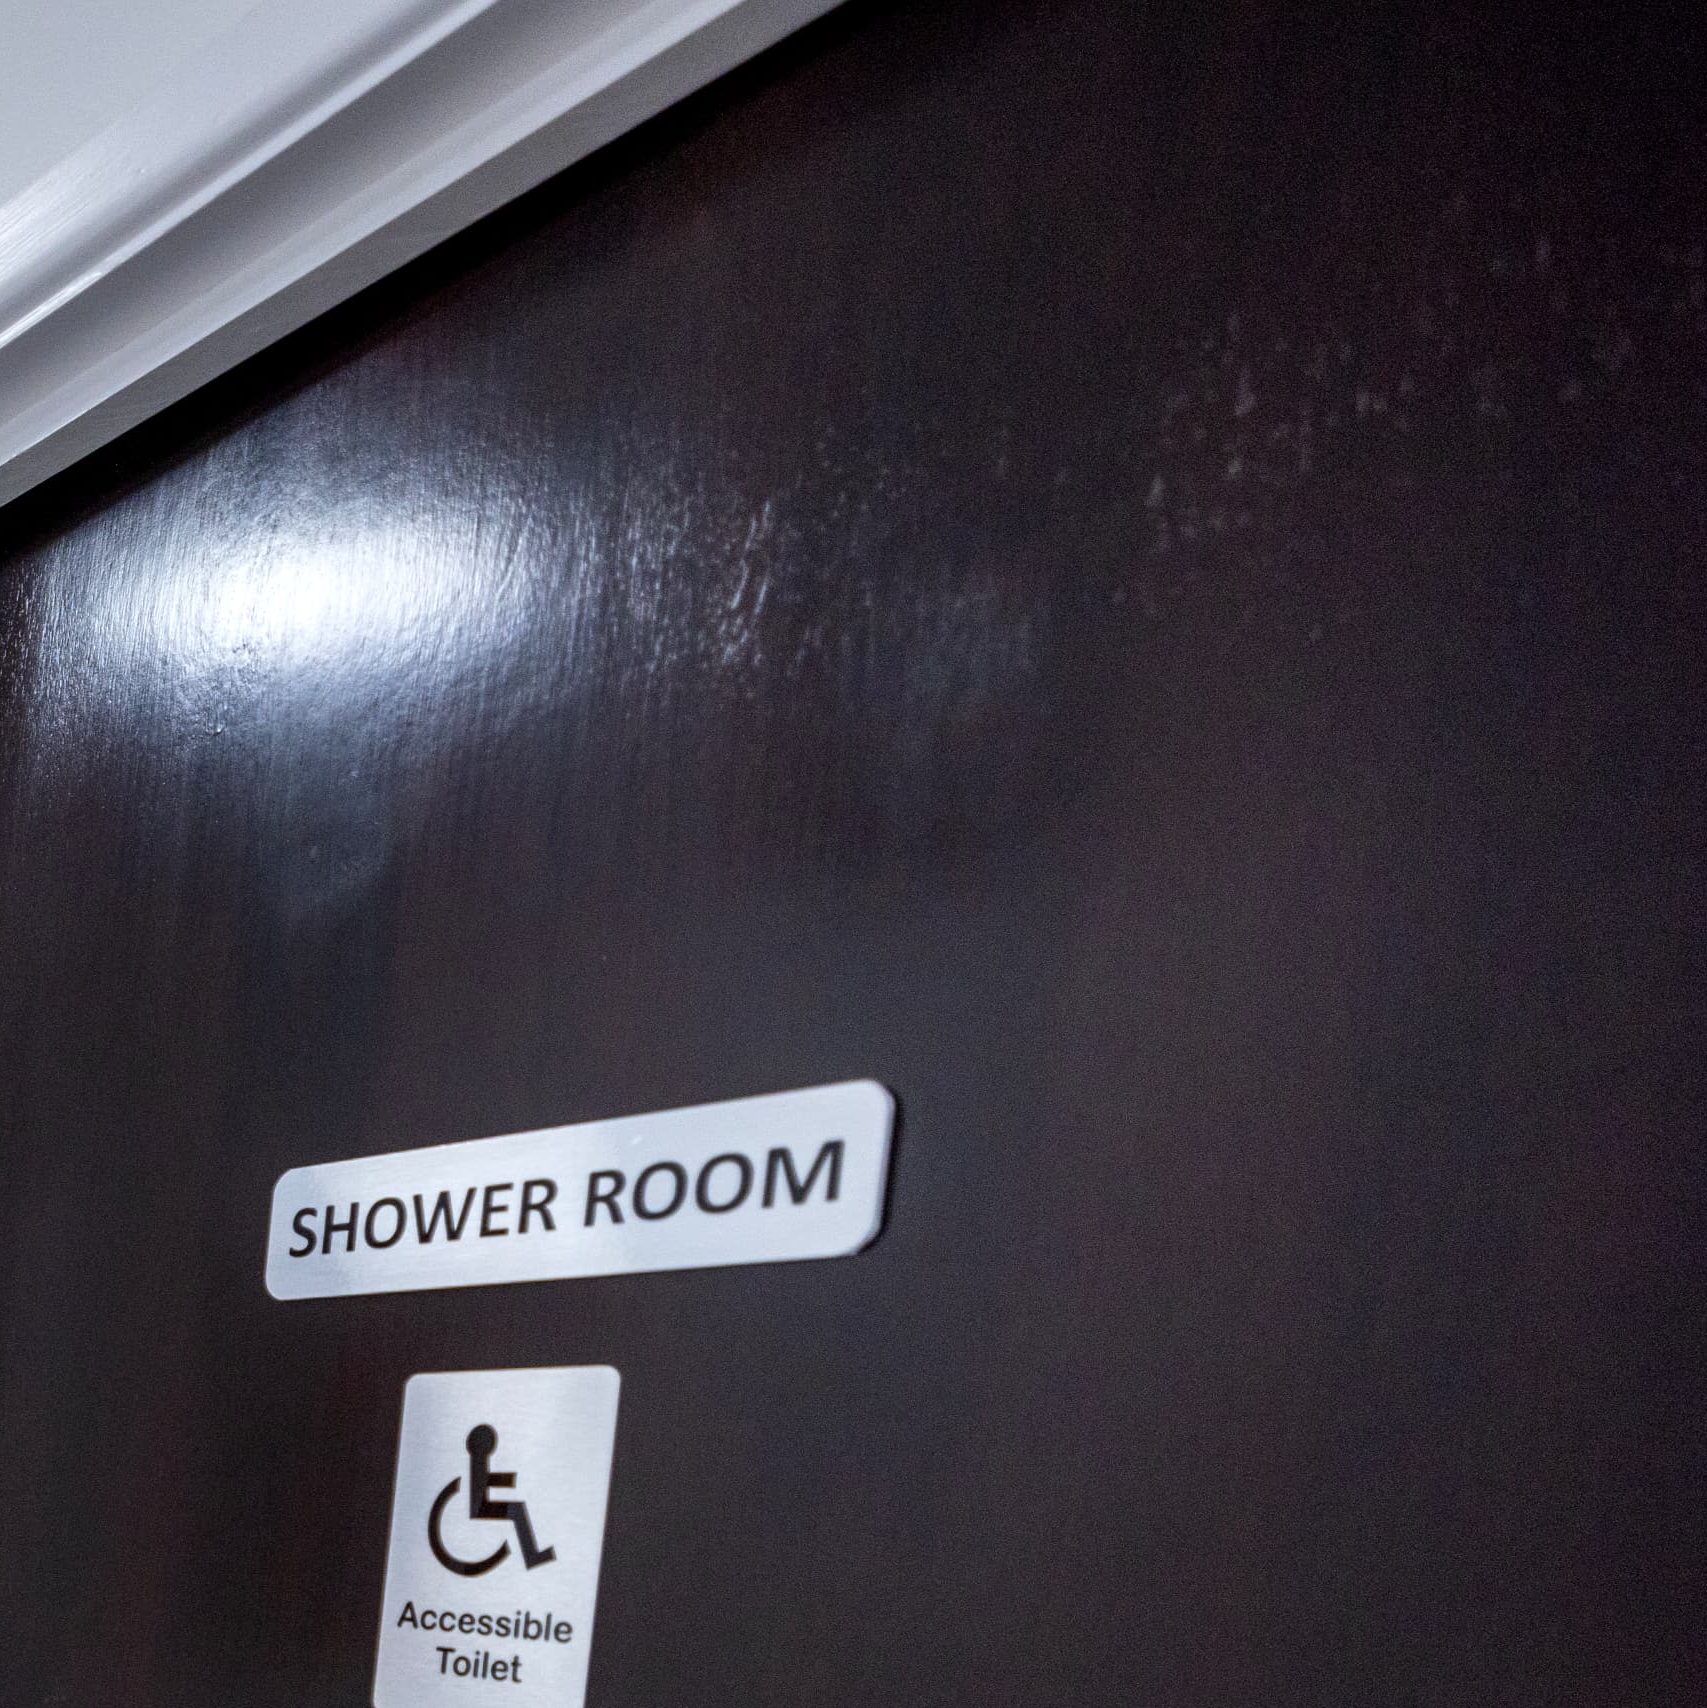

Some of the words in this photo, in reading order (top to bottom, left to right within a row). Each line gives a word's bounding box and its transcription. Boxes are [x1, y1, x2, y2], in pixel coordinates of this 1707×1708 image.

[289, 1178, 558, 1258] SHOWER
[584, 1140, 845, 1227] ROOM
[397, 1600, 573, 1643] Accessible
[436, 1646, 522, 1683] Toilet
